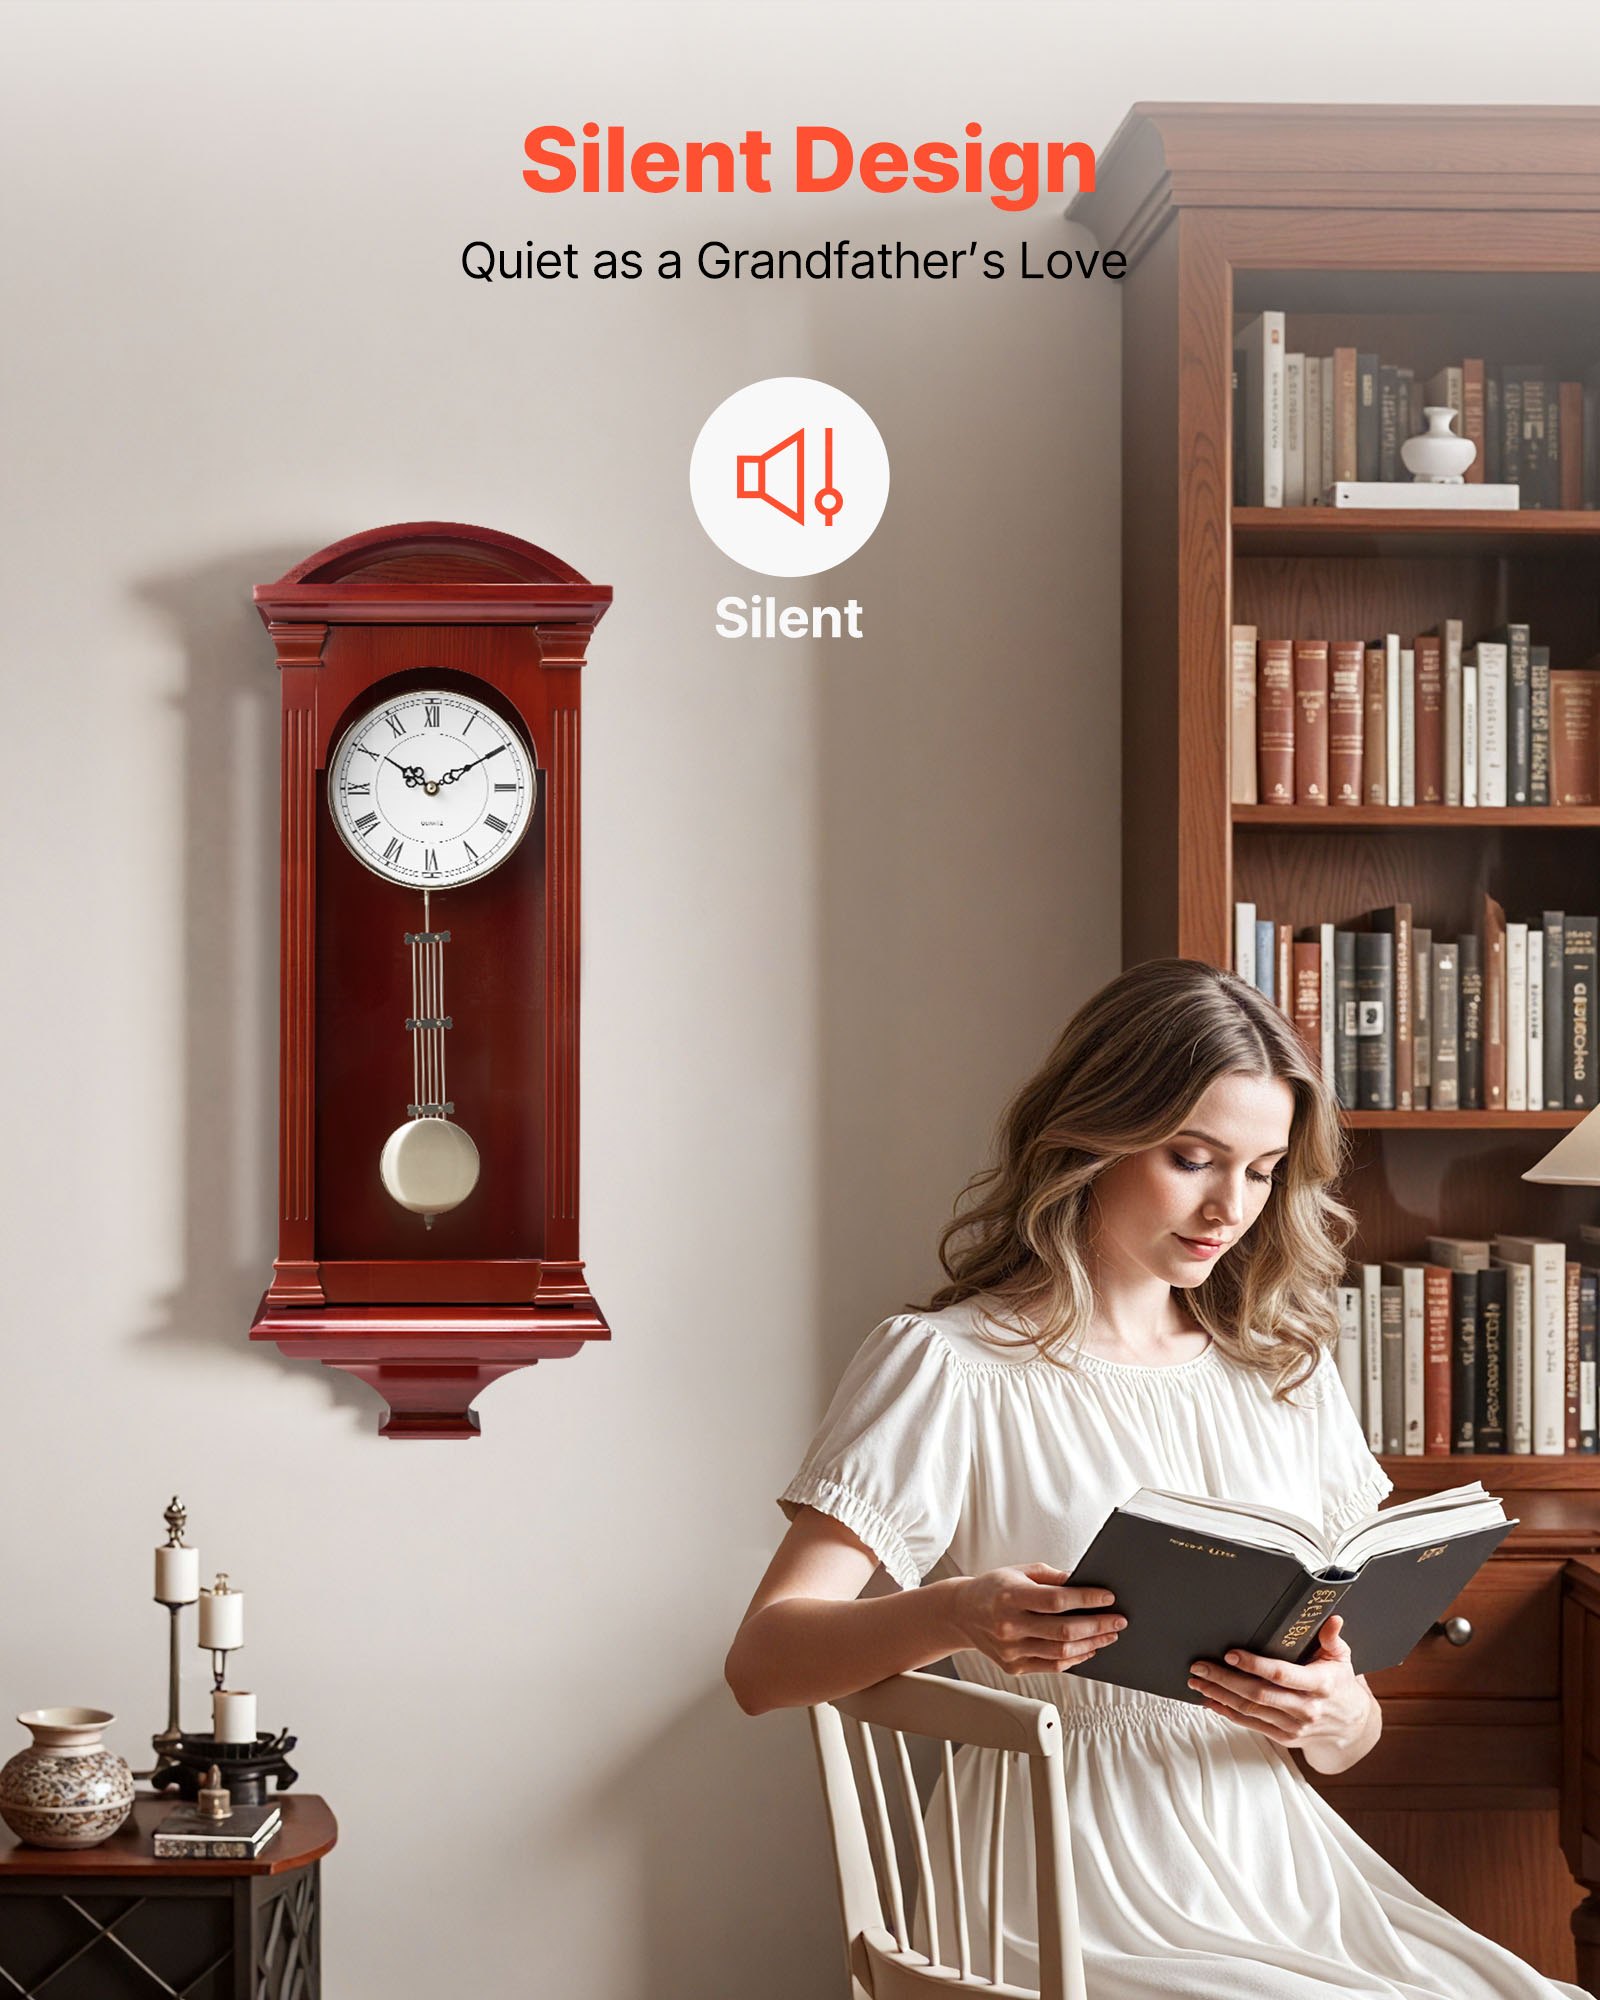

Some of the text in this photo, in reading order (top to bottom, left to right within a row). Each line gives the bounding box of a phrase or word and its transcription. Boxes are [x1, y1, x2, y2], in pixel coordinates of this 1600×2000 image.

[385, 714, 406, 739] XI
[424, 706, 440, 727] XII
[462, 715, 476, 736] I
[357, 743, 380, 762] X
[347, 782, 370, 795] IX
[383, 836, 404, 863] VII
[424, 848, 438, 871] VI
[463, 840, 478, 862] V
